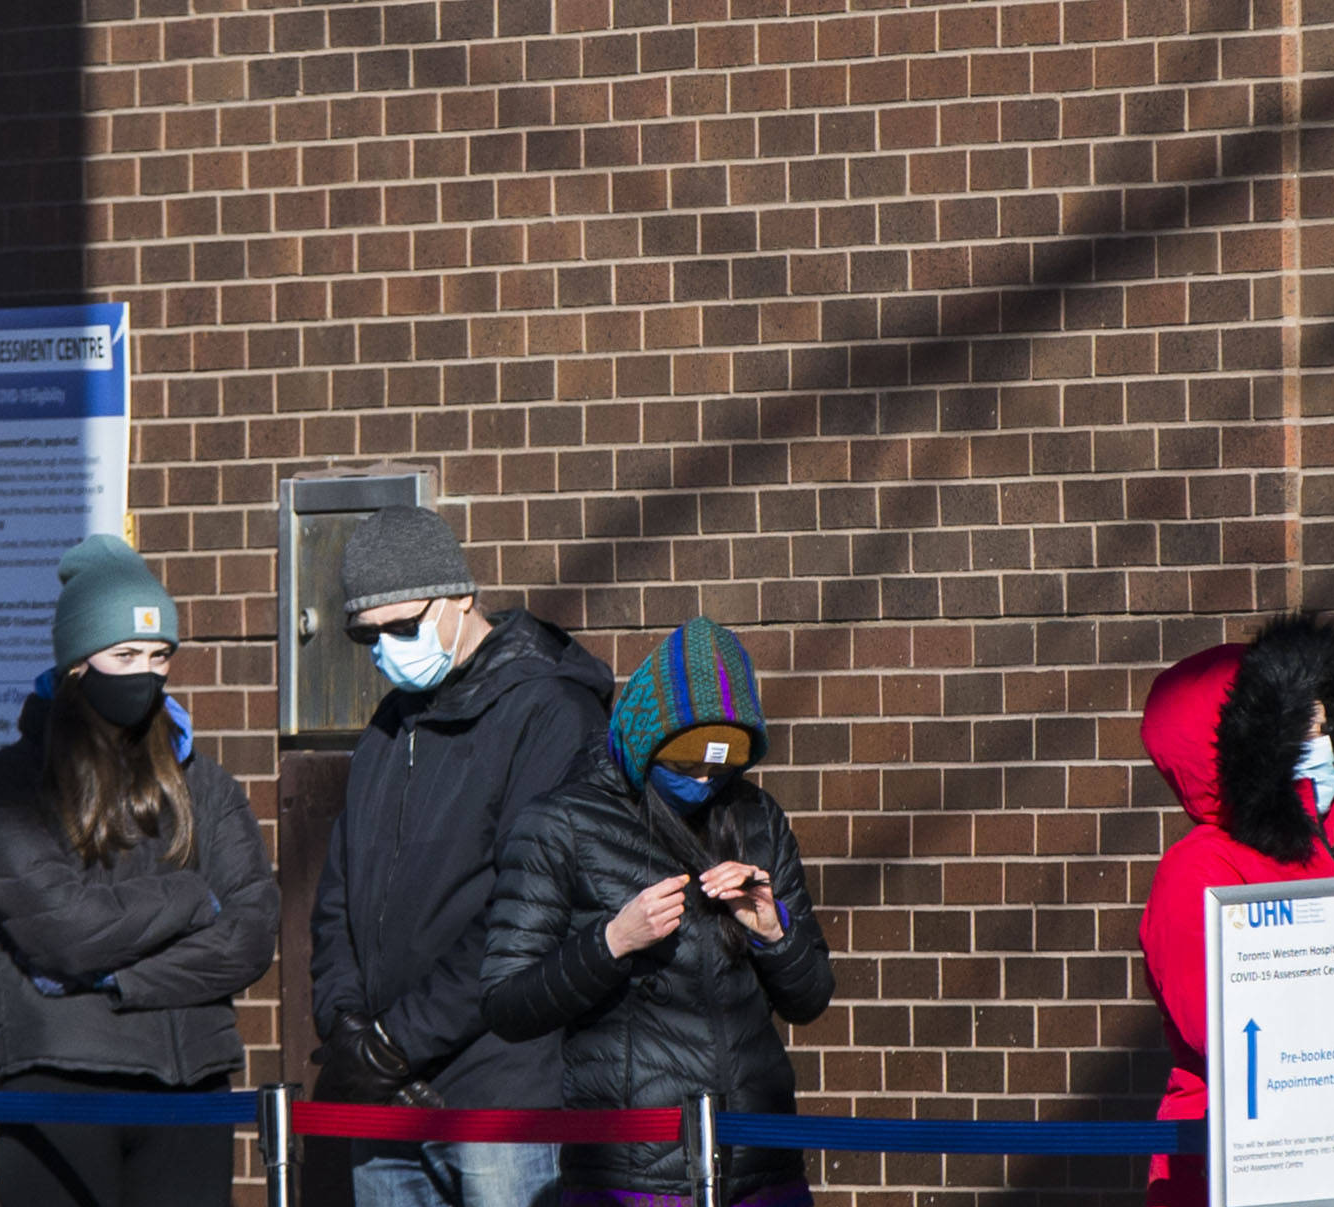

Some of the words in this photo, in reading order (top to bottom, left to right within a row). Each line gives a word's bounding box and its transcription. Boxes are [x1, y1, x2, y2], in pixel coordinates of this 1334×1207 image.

[56, 336, 104, 361] CENTRE
[1248, 898, 1294, 928] UHN
[1237, 951, 1271, 962] Toronto
[1273, 948, 1308, 959] Western
[1230, 971, 1272, 983] COVID-19
[1273, 967, 1322, 979] Assessment
